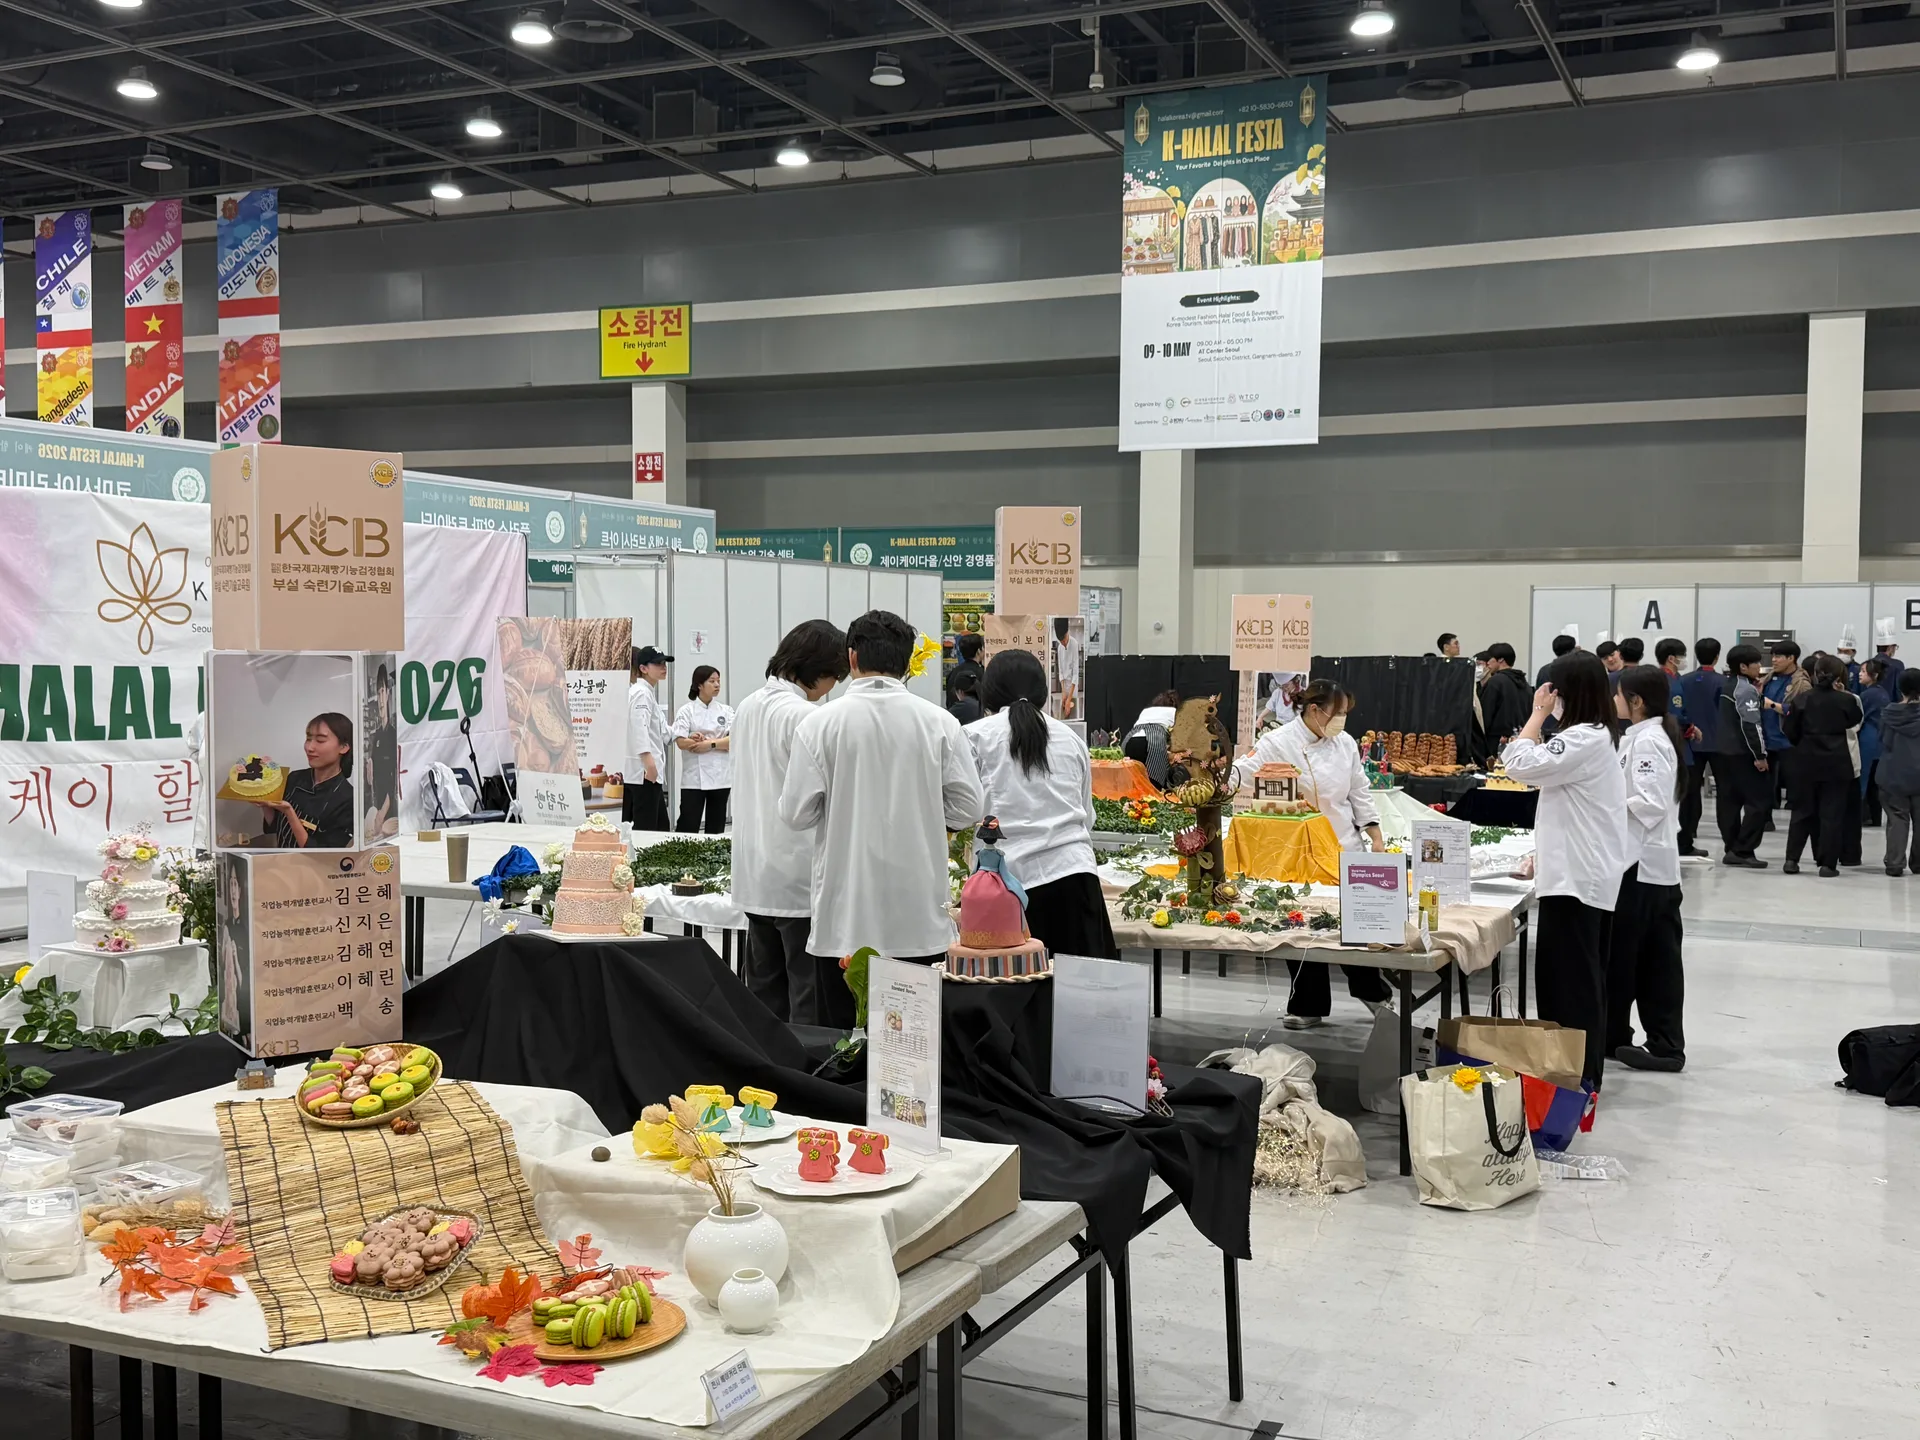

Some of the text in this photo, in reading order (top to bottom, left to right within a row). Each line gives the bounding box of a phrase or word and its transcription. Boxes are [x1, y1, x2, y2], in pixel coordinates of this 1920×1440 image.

[1162, 118, 1284, 162] K-HALAL FESTA
[1188, 162, 1211, 170] Favorite
[1213, 159, 1235, 167] Delights
[124, 231, 175, 282] VIETNAM
[217, 225, 272, 277] INDONESIA
[36, 238, 88, 292] CHILE
[220, 245, 278, 299] 인도네시아
[1213, 295, 1241, 304] Highlights:
[608, 307, 682, 338] 소화전
[637, 340, 666, 350] Hydrant
[1144, 344, 1154, 359] 09
[1162, 343, 1172, 358] 10
[1174, 342, 1191, 357] MAY
[38, 378, 88, 424] Bangladesh
[126, 371, 183, 424] INDIA
[218, 366, 271, 420] ITALY
[222, 393, 275, 442] 이탈리아
[638, 455, 662, 471] 소화전
[214, 513, 250, 558] KCB
[274, 511, 390, 558] KCB
[726, 537, 744, 546] FESTA
[745, 537, 761, 546] 2026
[890, 538, 918, 547] K-HALAL
[919, 537, 937, 546] FESTA
[938, 537, 956, 546] 2026
[880, 554, 994, 568] 제이케이다올/신안 경영품
[1010, 541, 1072, 565] KCB
[282, 562, 395, 576] 한국제과제빵기능검정협회
[552, 564, 573, 575] 에이스
[272, 578, 392, 594] 부설 숙련기술교육원
[1642, 600, 1662, 629] A
[192, 624, 212, 634] Seou
[1236, 620, 1273, 636] KCB
[1282, 620, 1309, 636] KCB
[400, 657, 486, 725] 026
[154, 760, 199, 824] 할
[261, 896, 332, 910] 직업능력개발훈련교사
[262, 924, 333, 939] 직업능력개발훈련교사
[263, 954, 334, 968] 직업능력개발훈련교사
[264, 982, 334, 997] 직업능력개발훈련교사
[265, 1011, 335, 1027] 직업능력개발훈련교사
[256, 1038, 299, 1058] KCB
[1485, 1168, 1526, 1186] Here
